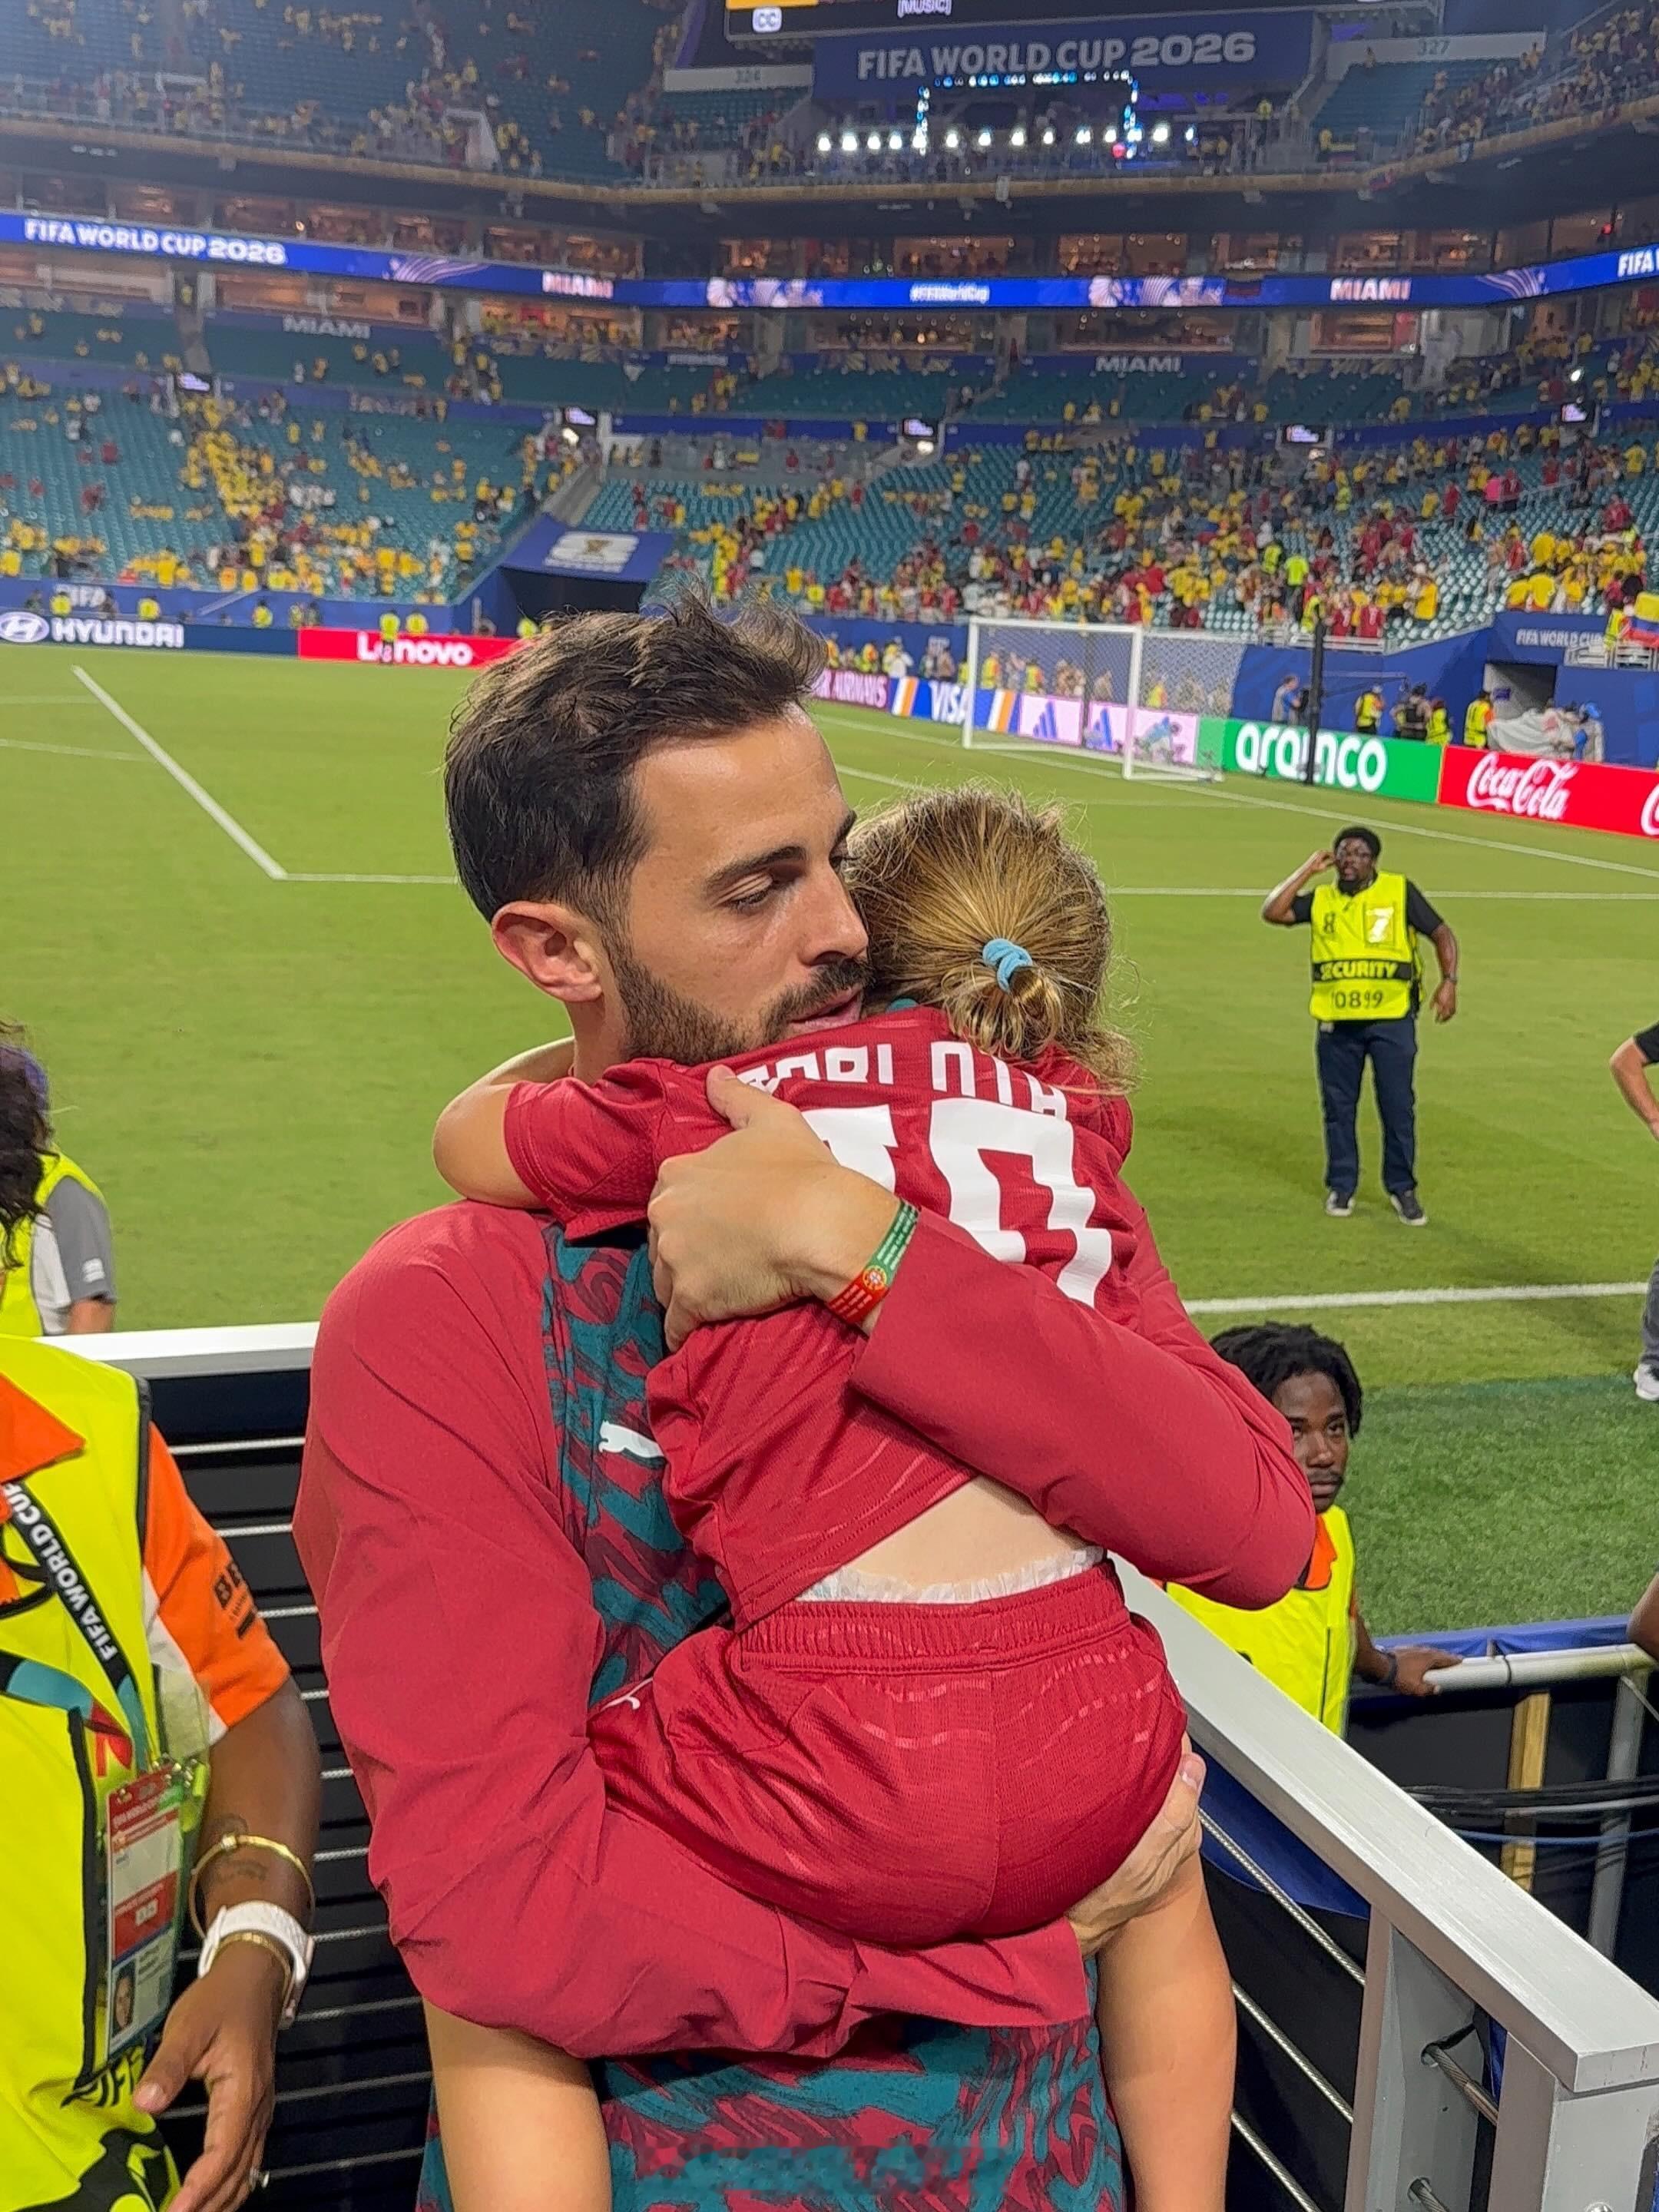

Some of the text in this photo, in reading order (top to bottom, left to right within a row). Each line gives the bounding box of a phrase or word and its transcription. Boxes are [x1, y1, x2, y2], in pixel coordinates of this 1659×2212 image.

[858, 31, 1255, 80] FIFA WORLD CUP 2026
[25, 217, 288, 265] FIFA WORLD CUP 2026
[1618, 249, 1654, 277] FIFA
[1330, 277, 1412, 301] MIAMI
[283, 314, 371, 339] MIAMI
[1095, 356, 1181, 373] MIAMI
[51, 617, 184, 648] HYUNDAI
[357, 631, 473, 665] Lenovo
[1516, 628, 1538, 645] FIFA
[1539, 630, 1578, 647] WORLD
[1236, 722, 1387, 793] aramco
[1366, 906, 1394, 943] 7
[31, 1524, 90, 1611] WORLD
[80, 1606, 118, 1661] FIFA
